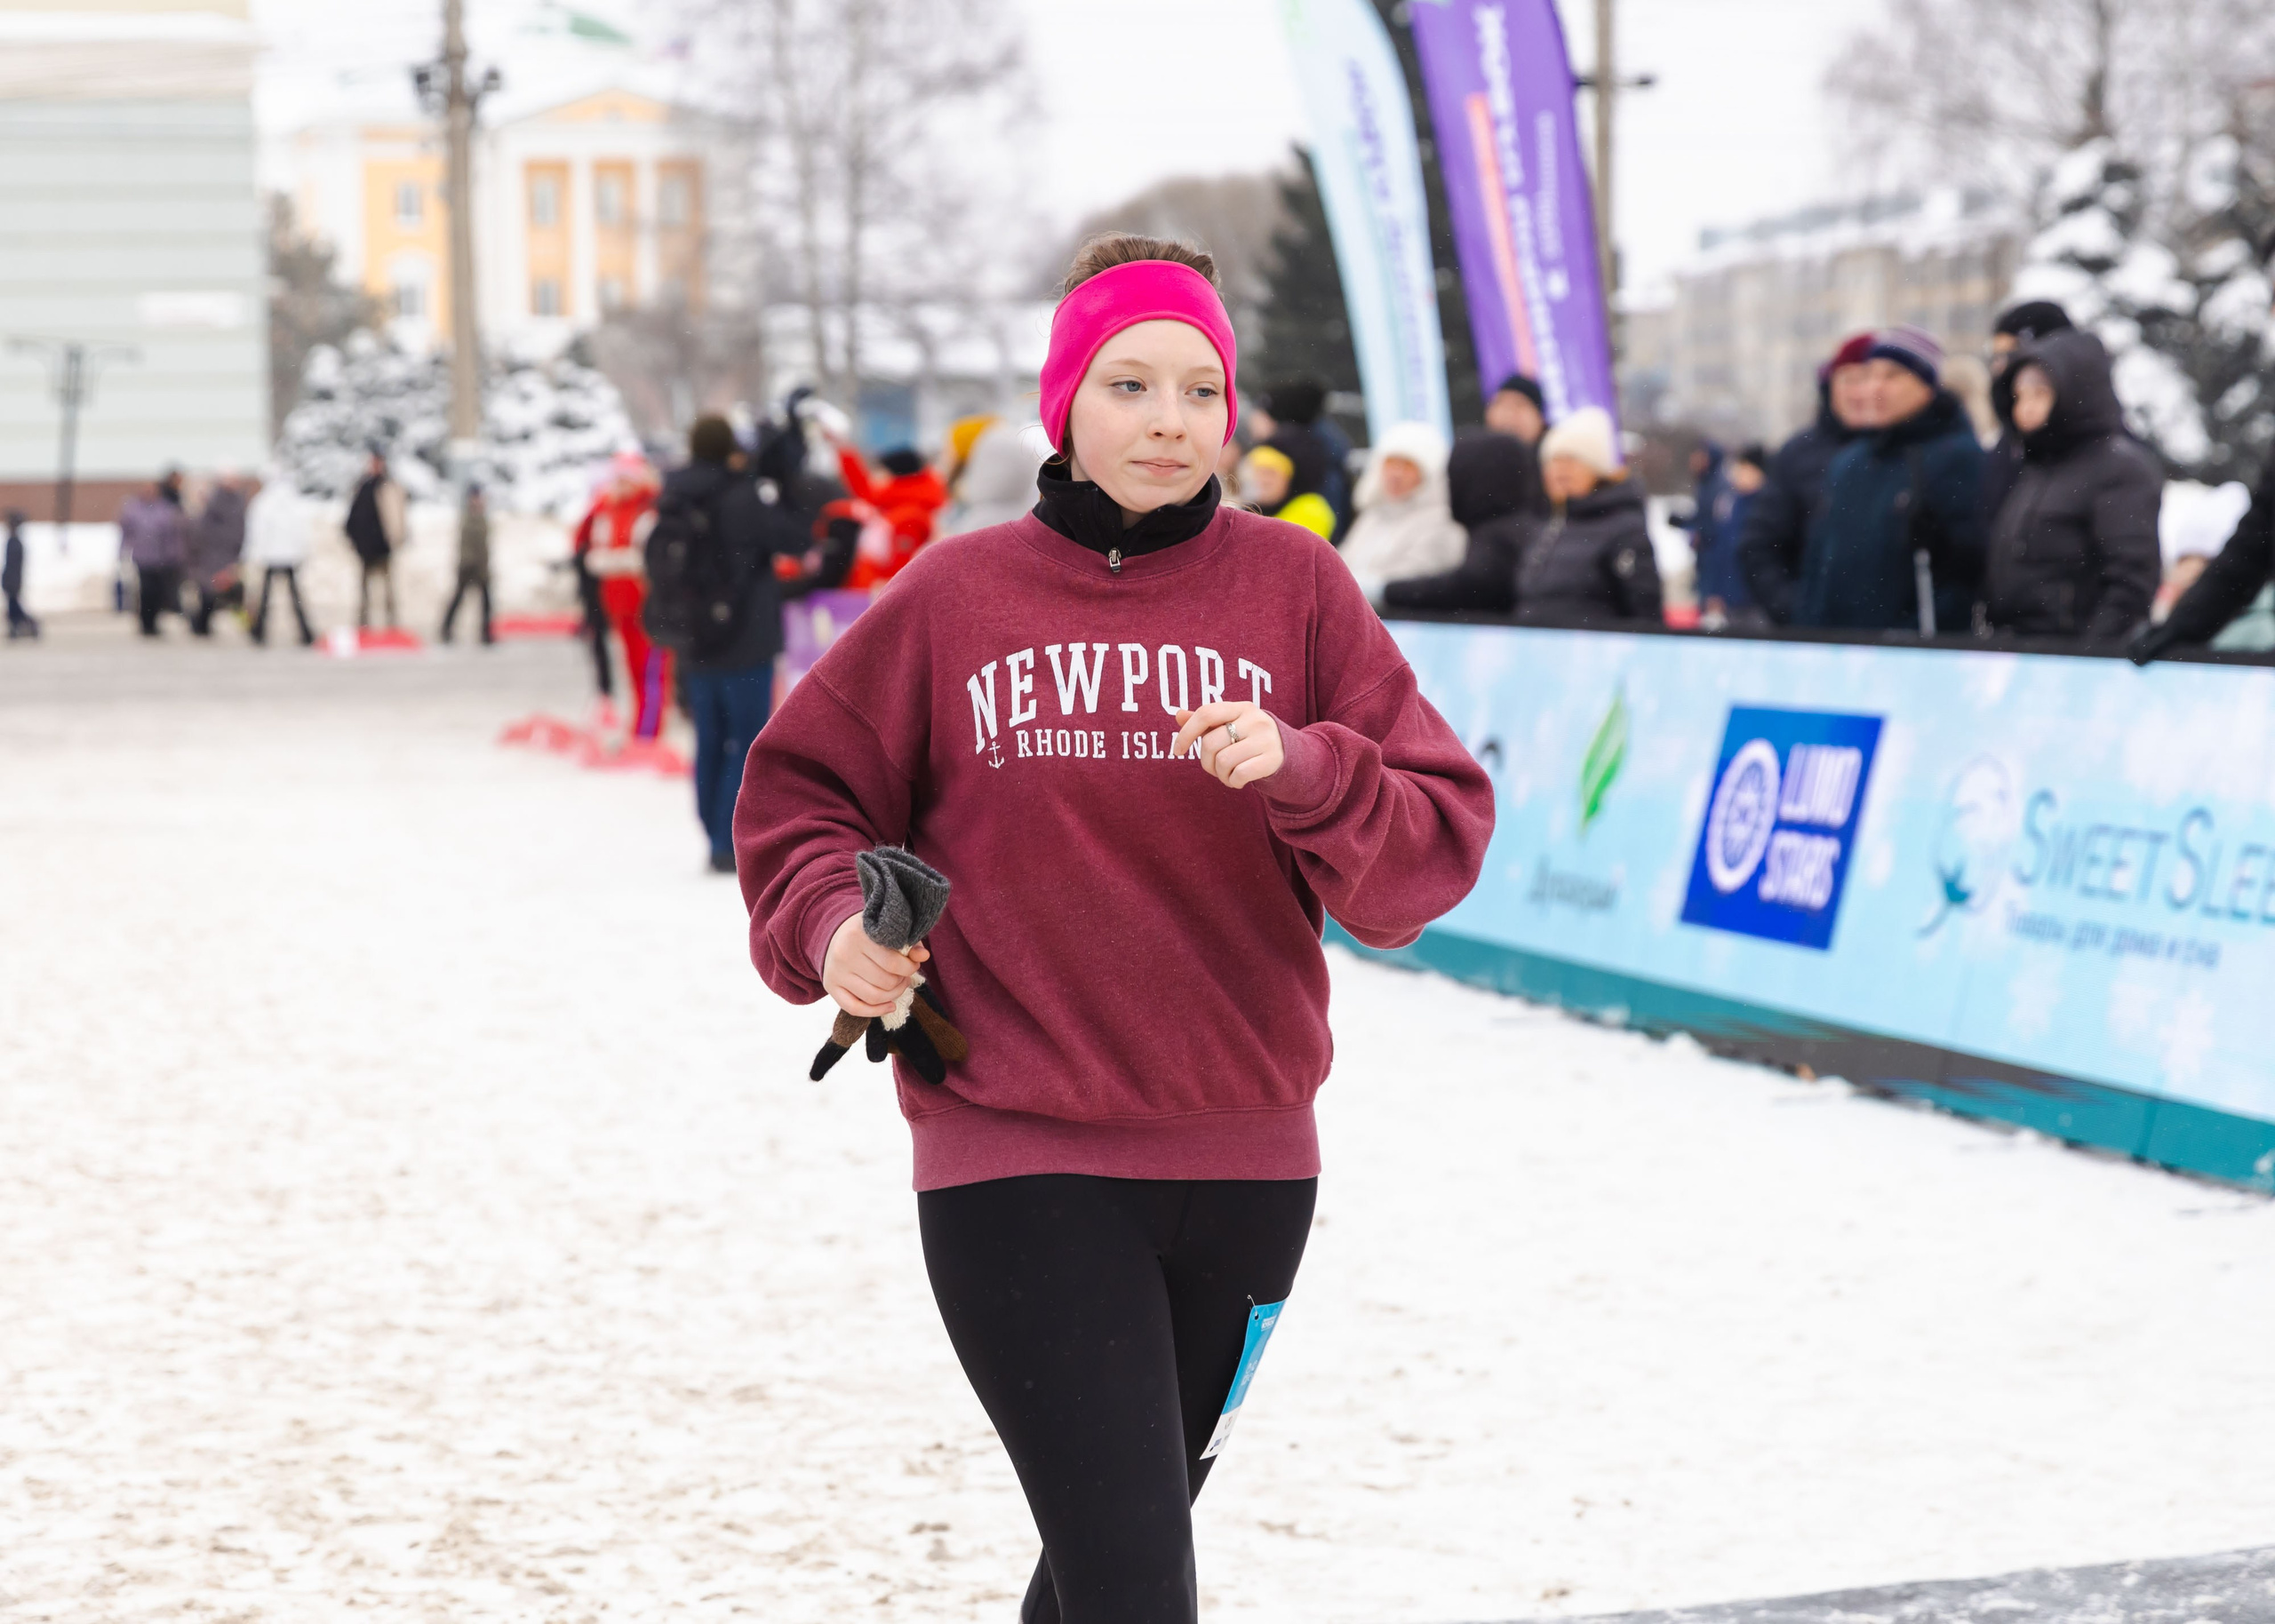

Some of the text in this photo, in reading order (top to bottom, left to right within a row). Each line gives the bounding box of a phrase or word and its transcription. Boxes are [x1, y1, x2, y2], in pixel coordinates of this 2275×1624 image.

[967, 642, 1272, 754] NEWPORT
[1016, 728, 1202, 760] RHODE ISLAN
